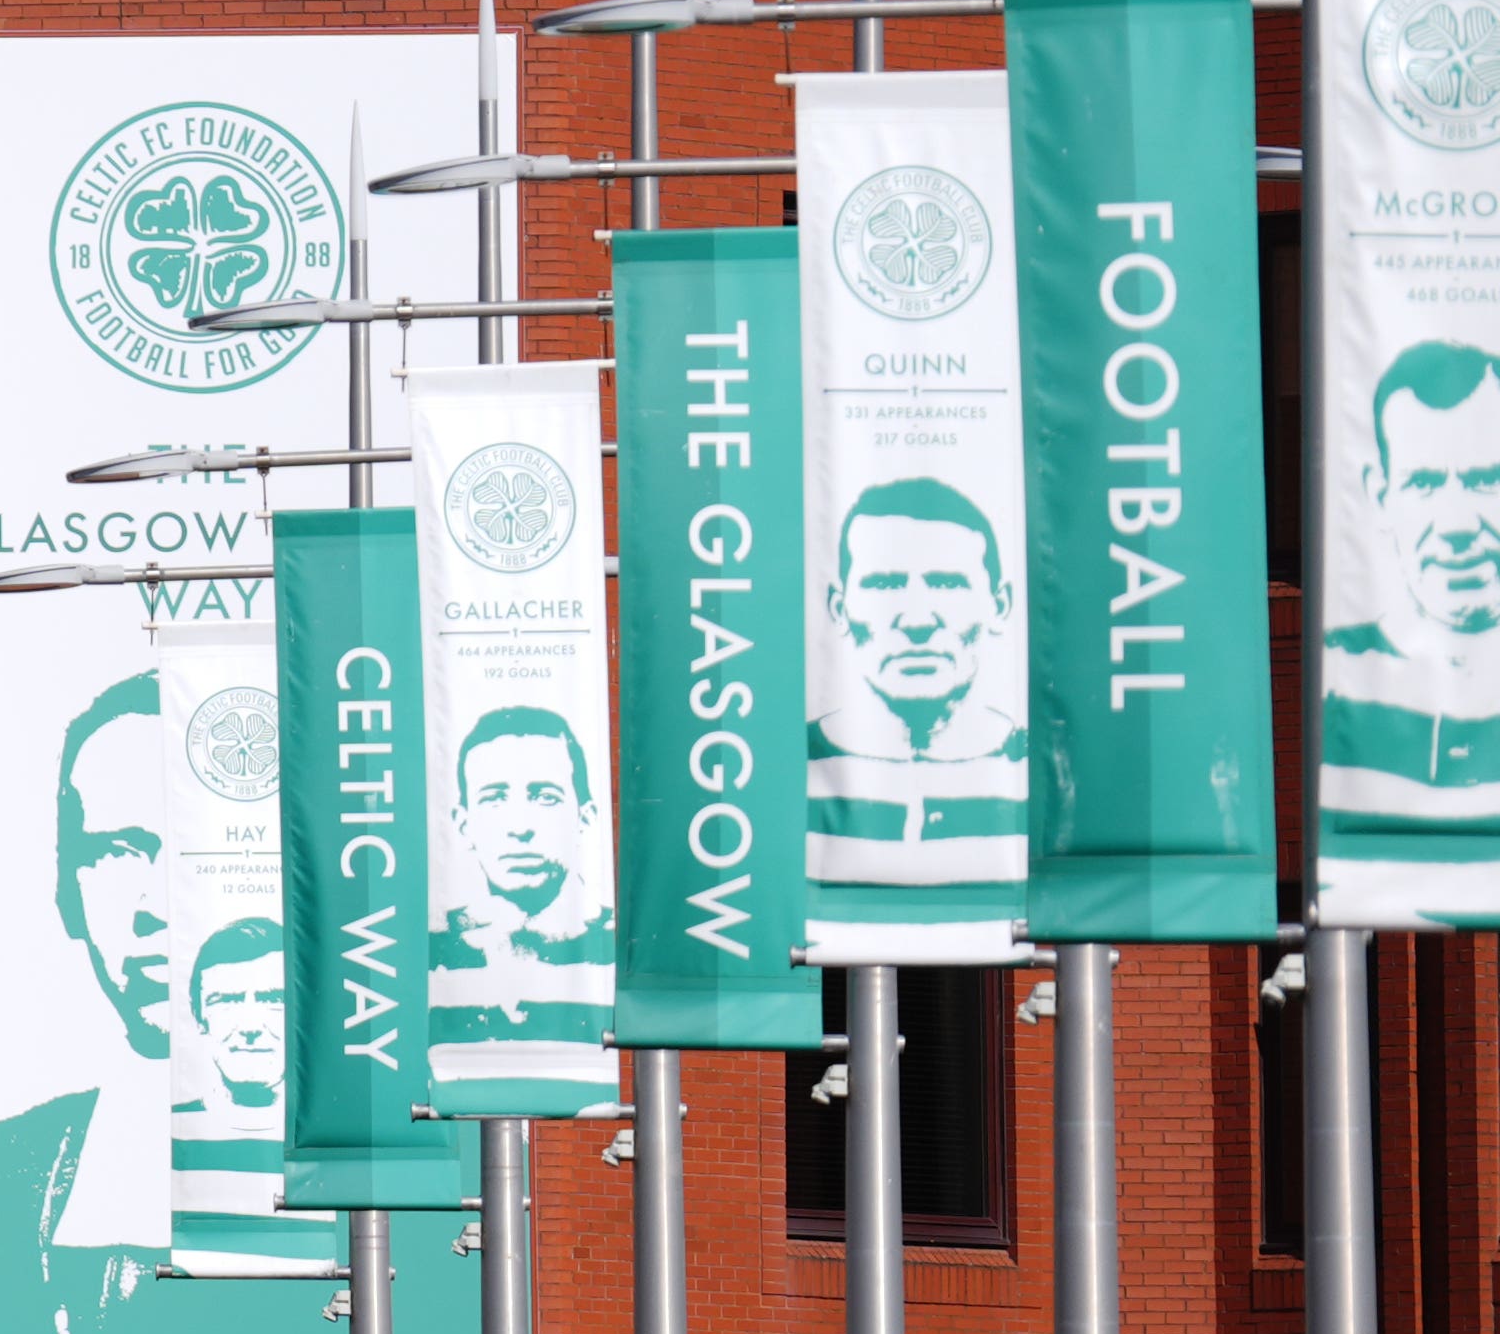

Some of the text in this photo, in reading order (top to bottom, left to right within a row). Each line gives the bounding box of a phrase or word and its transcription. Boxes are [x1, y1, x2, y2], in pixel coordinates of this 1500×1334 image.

[70, 117, 327, 224] CELTIC FC FOUNDATION
[1375, 190, 1498, 217] McGRO
[70, 244, 91, 269] 18
[305, 242, 331, 267] 88
[1411, 255, 1500, 269] APPEARA
[1444, 287, 1500, 302] GOAL
[75, 289, 188, 378] FOOTBALL
[205, 342, 256, 378] FOR
[864, 354, 967, 376] QUINN
[844, 406, 988, 419] 331 APPEARANCES
[874, 432, 958, 446] 217 GOALS
[1097, 201, 1187, 712] FOOTBALL
[136, 578, 263, 621] WAY
[444, 600, 584, 620] GALLACHER
[684, 318, 755, 960] THE GLASGOW
[457, 644, 576, 657] 464 APPEARANCES
[483, 667, 552, 679] 192 GOALS
[226, 826, 267, 842] HAY
[336, 645, 400, 1072] CELTIC WAY
[195, 865, 282, 875] 240 APPEARAN
[222, 883, 276, 894] 12 GOALS
